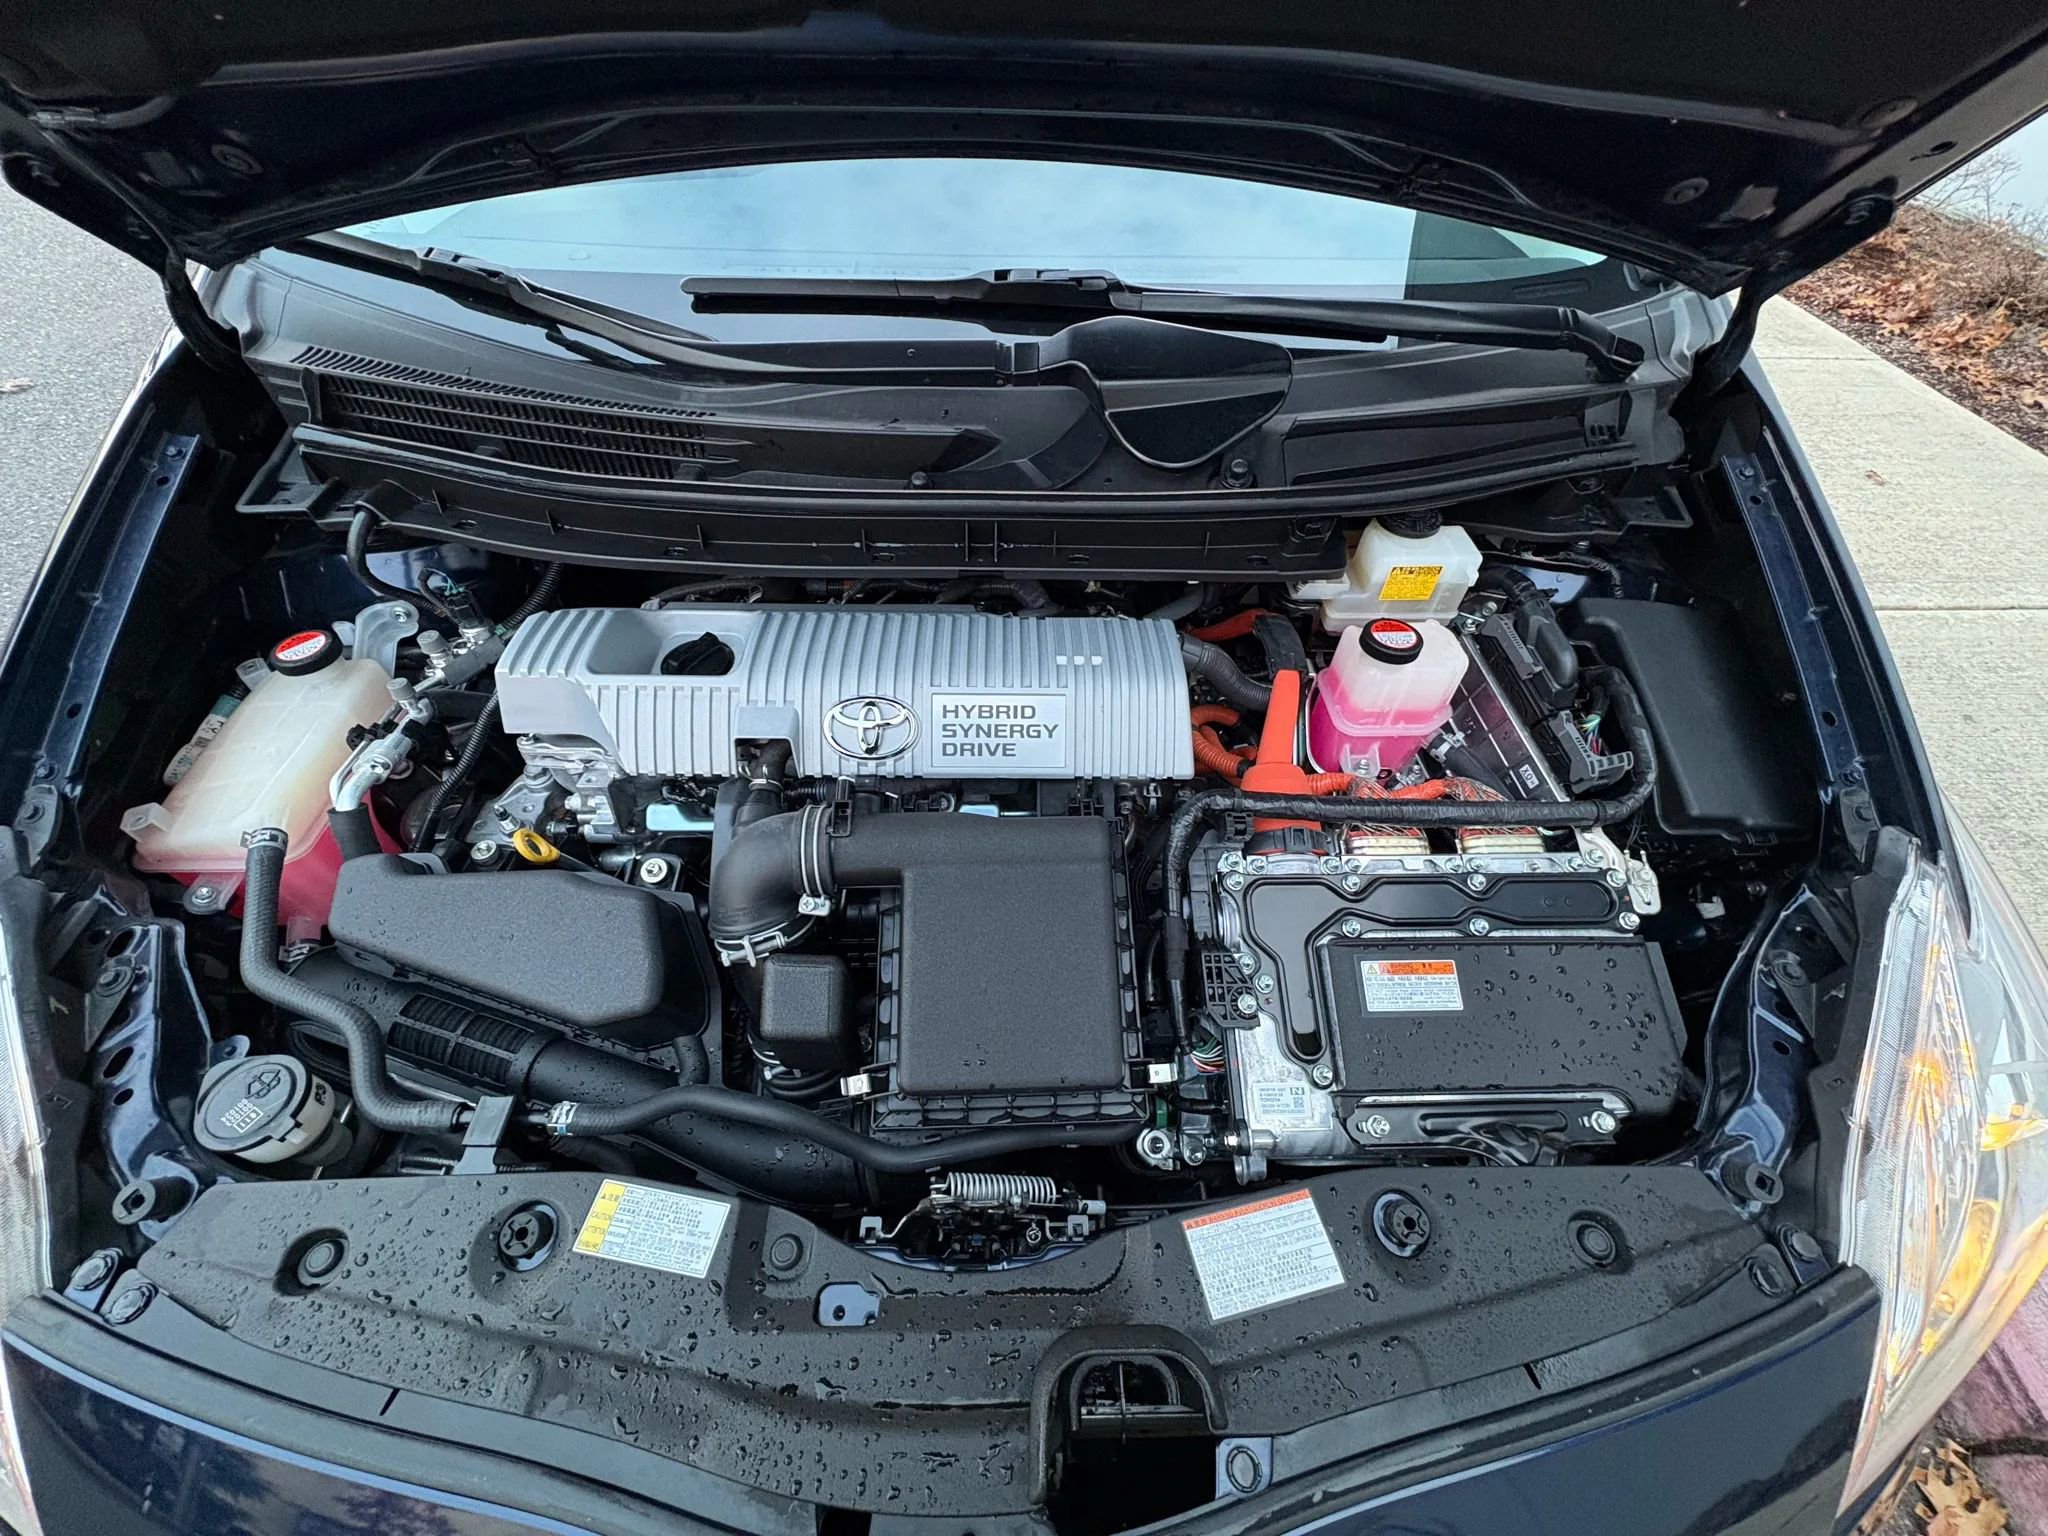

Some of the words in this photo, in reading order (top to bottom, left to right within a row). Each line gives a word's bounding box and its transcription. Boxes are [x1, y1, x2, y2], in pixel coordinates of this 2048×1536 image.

[942, 704, 1036, 719] HYBRID
[942, 723, 1059, 739] SYNERGY
[942, 742, 1017, 757] DRIVE
